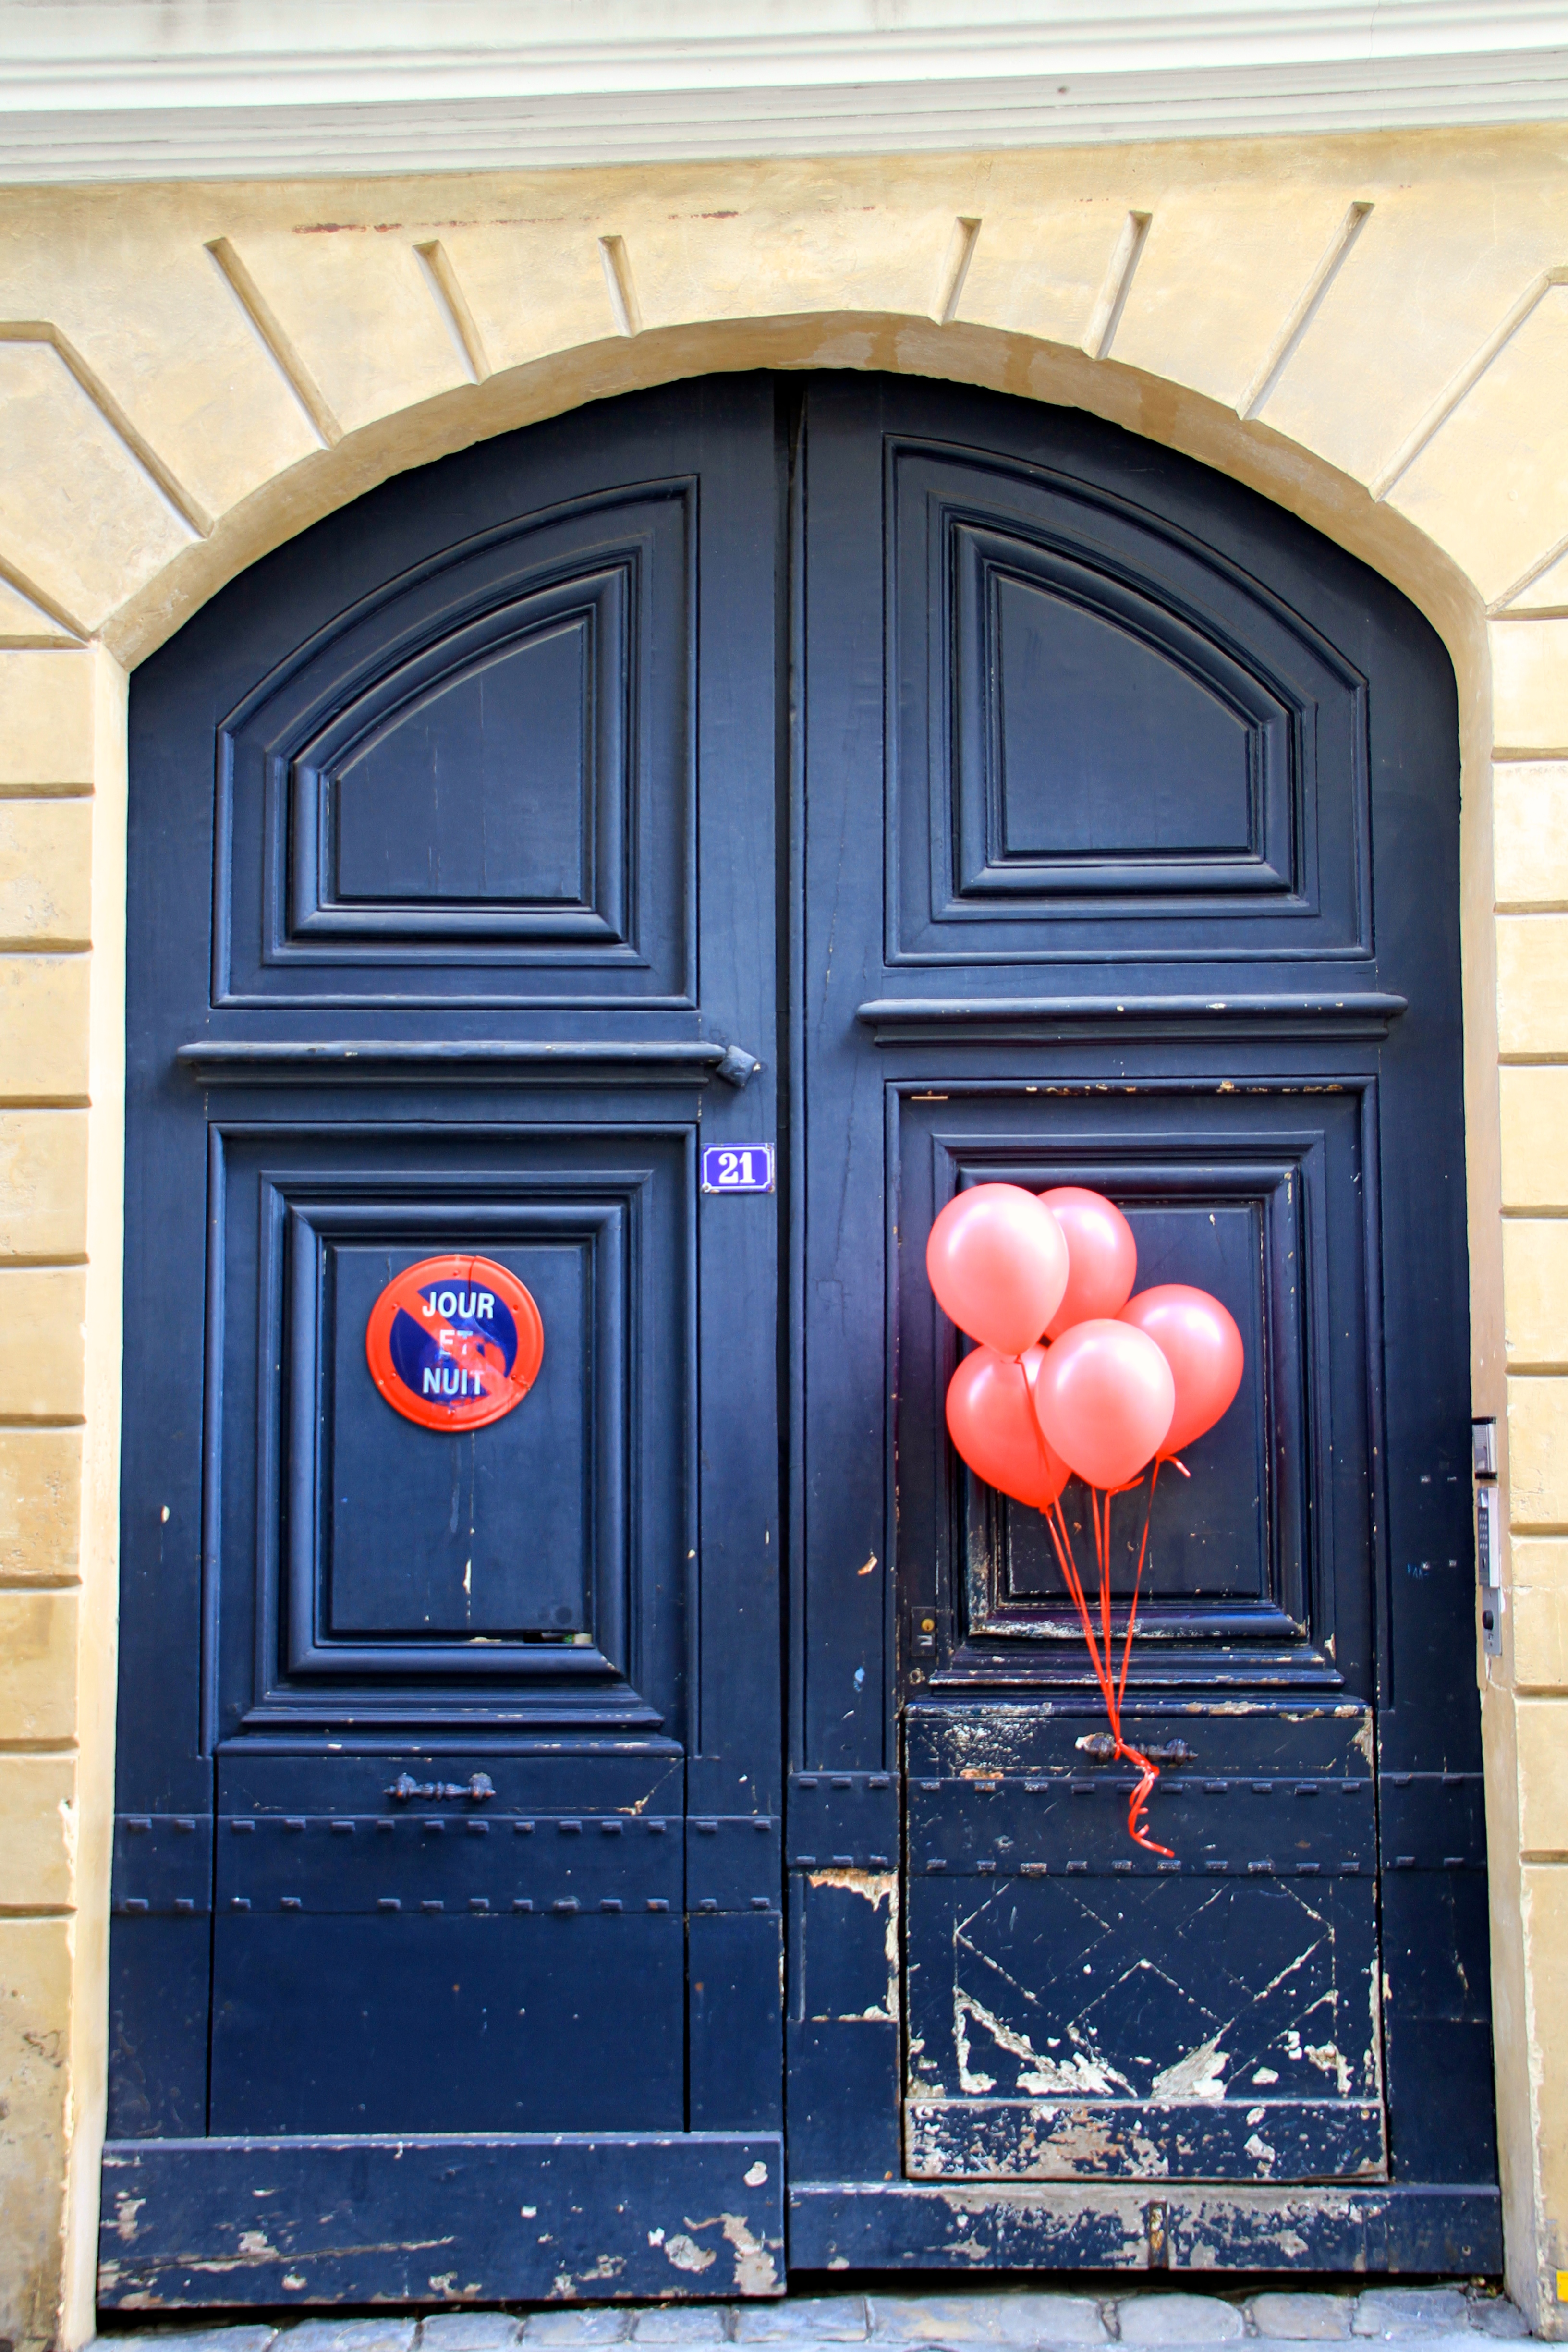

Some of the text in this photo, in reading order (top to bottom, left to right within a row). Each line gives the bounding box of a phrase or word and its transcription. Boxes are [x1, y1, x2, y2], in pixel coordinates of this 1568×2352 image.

[719, 1152, 756, 1183] 21
[422, 1291, 495, 1319] JOUR
[439, 1329, 473, 1355] ET
[423, 1367, 485, 1395] NUIT
